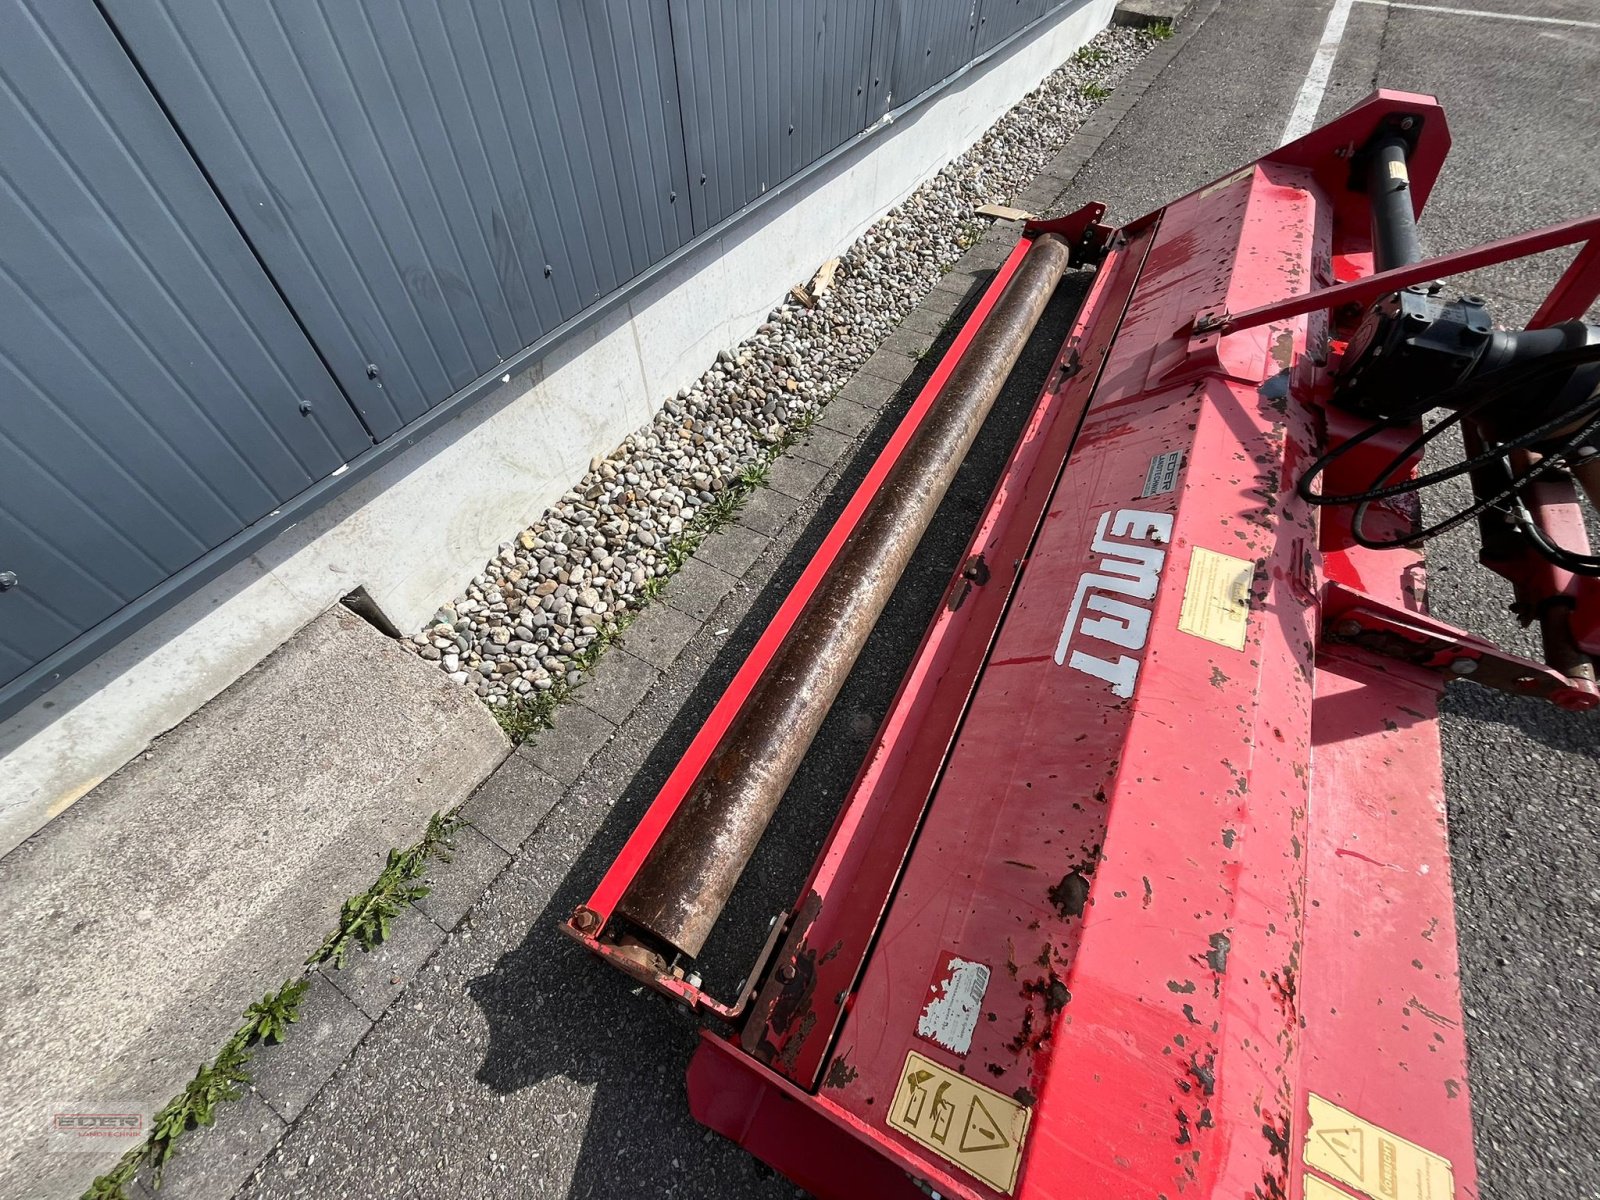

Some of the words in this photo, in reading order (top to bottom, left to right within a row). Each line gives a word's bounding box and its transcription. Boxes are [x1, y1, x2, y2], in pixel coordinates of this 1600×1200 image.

[1150, 454, 1166, 495] LANDTECHNIK
[1162, 451, 1179, 491] EDER
[1542, 453, 1562, 468] BAR
[1381, 1141, 1394, 1194] VORSICHT
